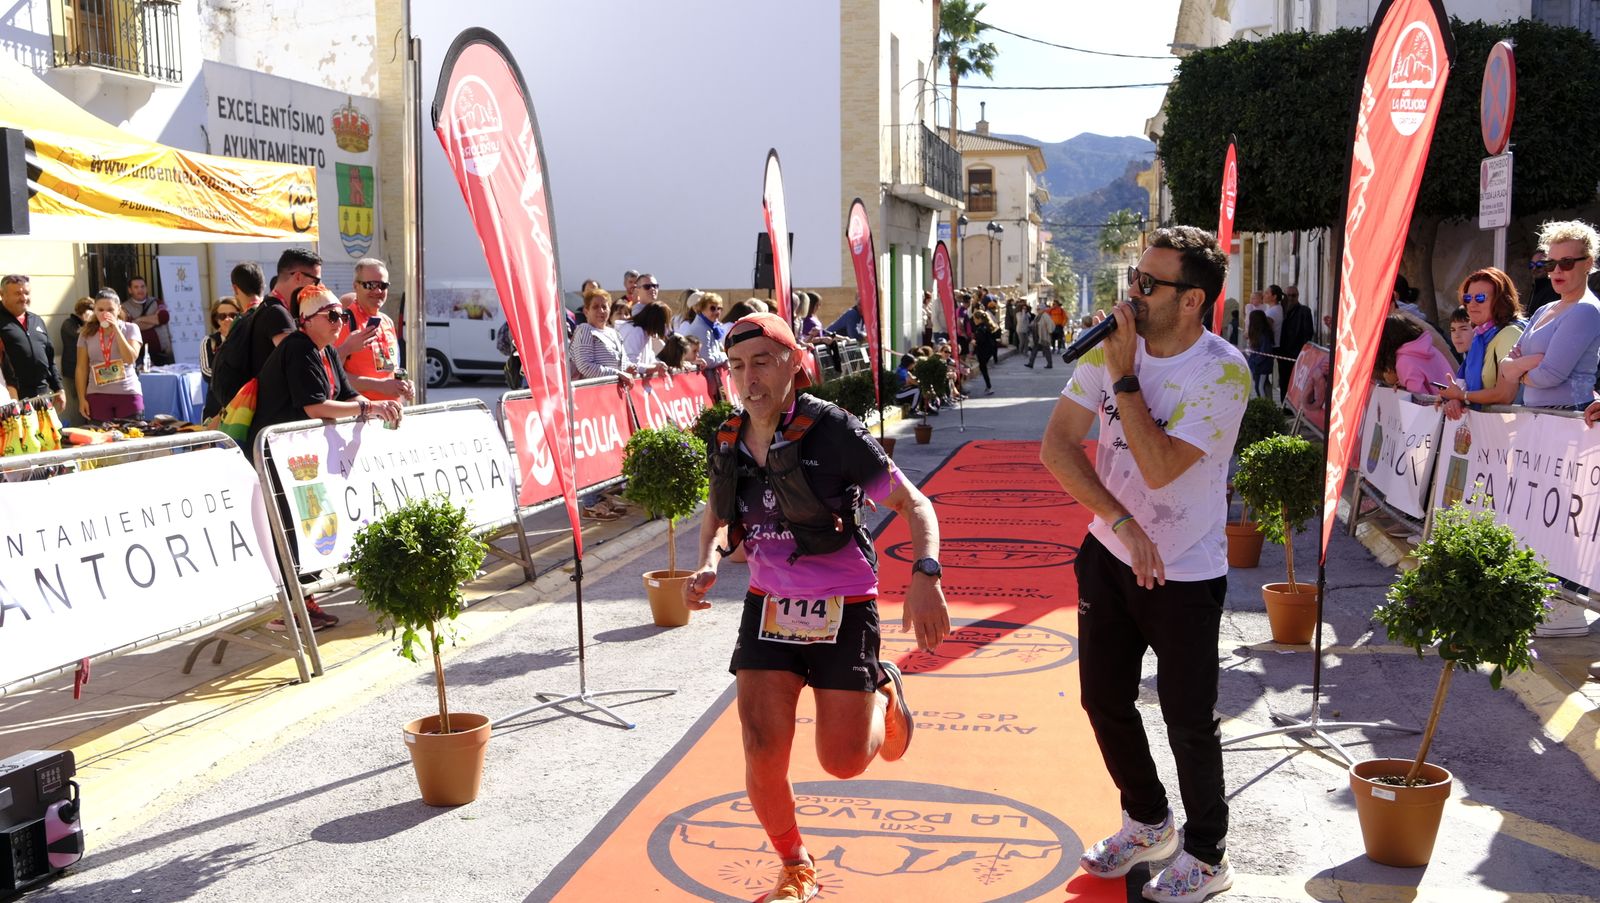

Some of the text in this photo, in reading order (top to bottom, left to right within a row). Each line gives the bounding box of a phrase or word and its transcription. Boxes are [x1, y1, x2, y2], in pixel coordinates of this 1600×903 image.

[218, 95, 325, 136] EXCELENTÍSIMO
[223, 134, 326, 169] AYUNTAMIENTO
[473, 437, 492, 453] DE
[344, 458, 504, 522] CANTORIA
[205, 488, 235, 513] DE
[779, 598, 827, 618] 114
[977, 713, 1018, 722] de
[880, 820, 936, 833] Cxm
[971, 813, 1029, 829] LA
